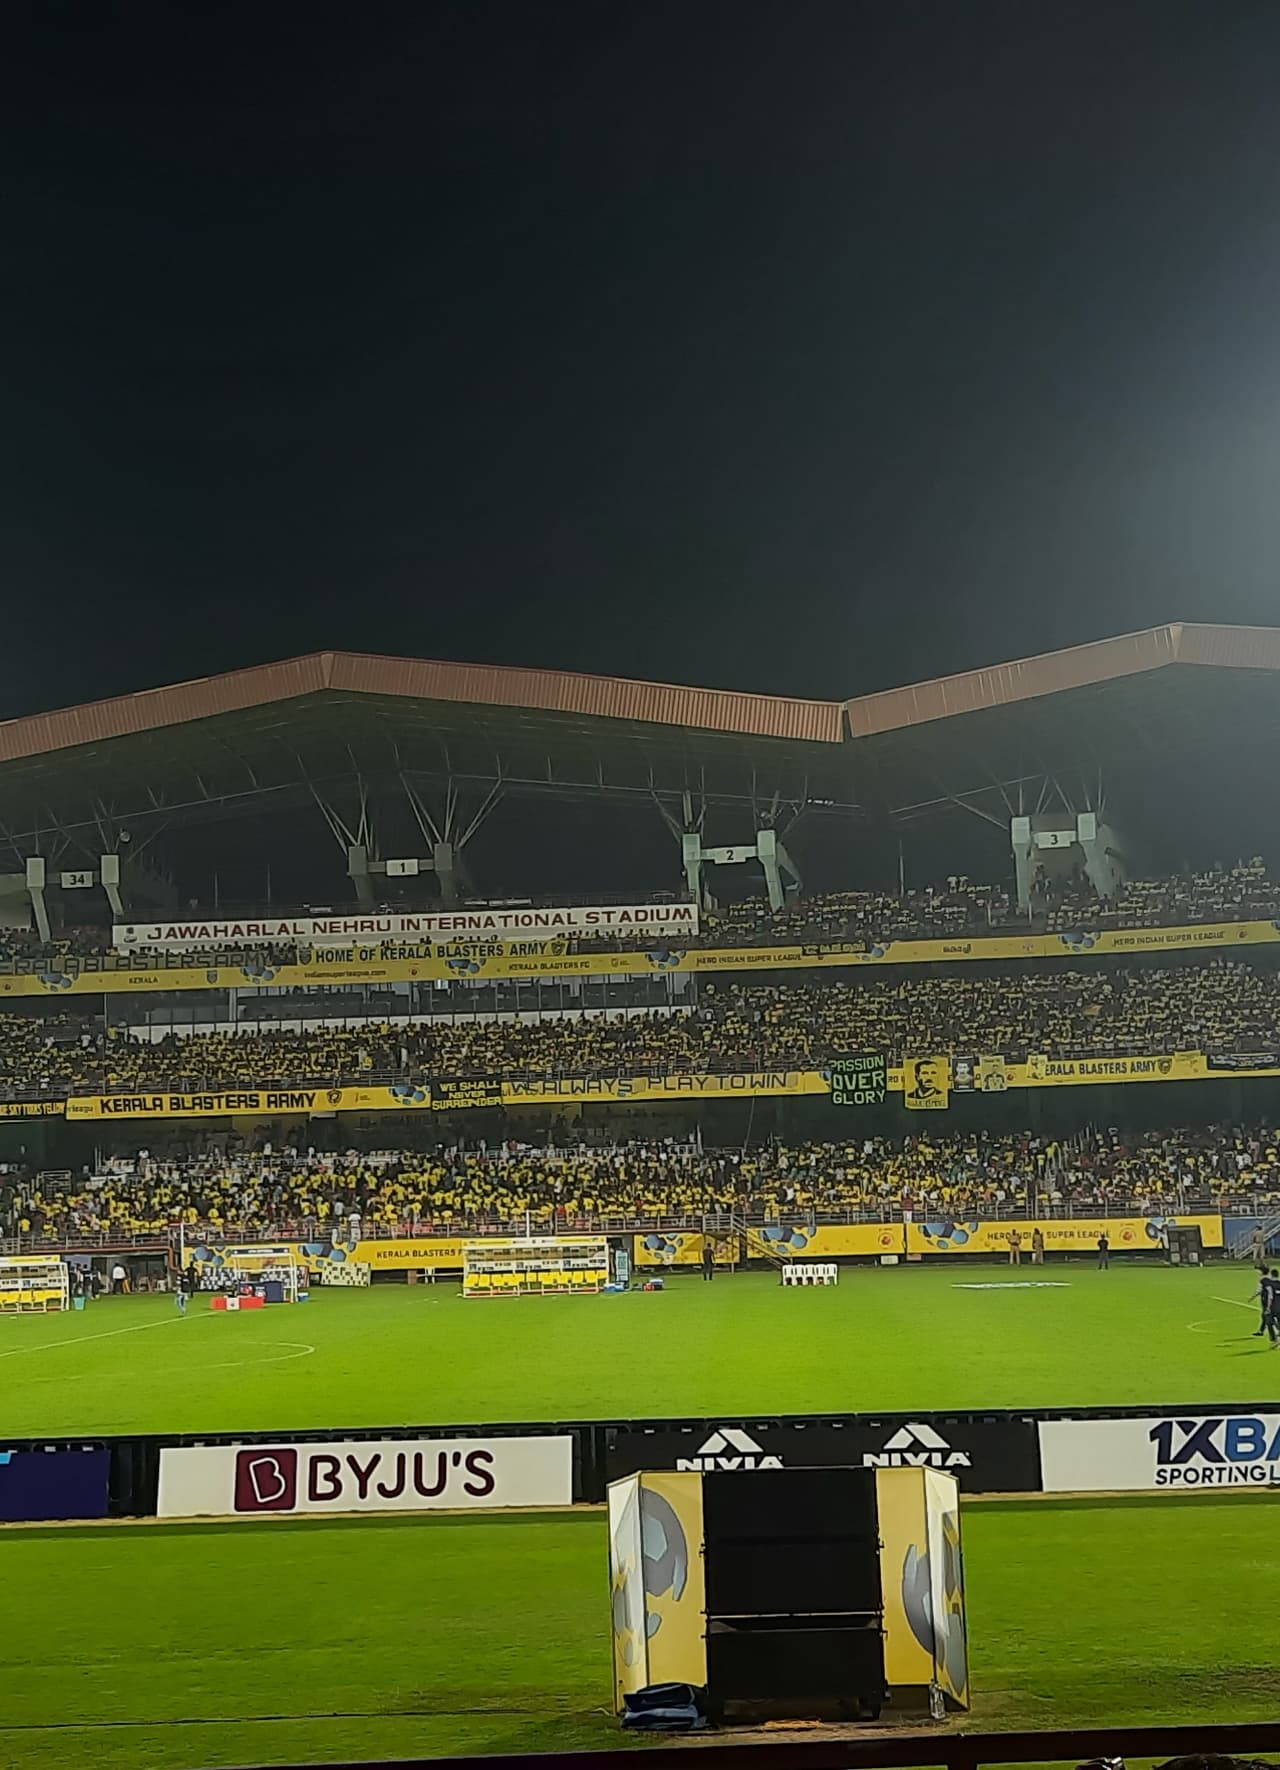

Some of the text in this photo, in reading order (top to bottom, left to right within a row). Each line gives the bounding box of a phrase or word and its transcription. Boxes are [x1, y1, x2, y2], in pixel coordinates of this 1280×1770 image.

[1050, 834, 1058, 845] 3
[726, 850, 734, 860] 2
[400, 862, 405, 873] 1
[69, 874, 85, 885] 34
[147, 908, 693, 941] JAWAHARLAL NEHRU INTERNATIONAL STADIUM
[1114, 931, 1224, 947] HERO INDIAN SUPER LEAGUE
[316, 942, 547, 964] HOME OF KERALA BLASTERS ARMY
[697, 953, 801, 966] HERO INDIAN SUPER LEAGUE
[509, 960, 590, 971] KERALA BLASTERS FC
[129, 976, 158, 985] KERALA
[830, 1056, 884, 1072] PASSION
[1046, 1060, 1156, 1076] ERALA BLASTERS ARMY
[440, 1080, 499, 1092] WE SHALL
[543, 1078, 632, 1094] ALWAYS
[648, 1076, 707, 1091] PLAY
[831, 1070, 884, 1089] OVER
[449, 1090, 486, 1099] NEVER
[833, 1088, 886, 1105] GLORY
[100, 1098, 161, 1114] KERALA
[169, 1094, 260, 1112] BLASTERS
[266, 1092, 316, 1109] ARMY
[432, 1097, 501, 1110] SURRENDER
[1046, 1230, 1074, 1239] SUPER
[1077, 1229, 1109, 1239] LEAGUE
[376, 1249, 455, 1259] KERALA BLASTERS
[676, 1454, 783, 1469] NIVIA
[864, 1450, 971, 1467] NIVIA
[307, 1449, 495, 1502] BYJU'S
[1155, 1463, 1266, 1486] SPORTING
